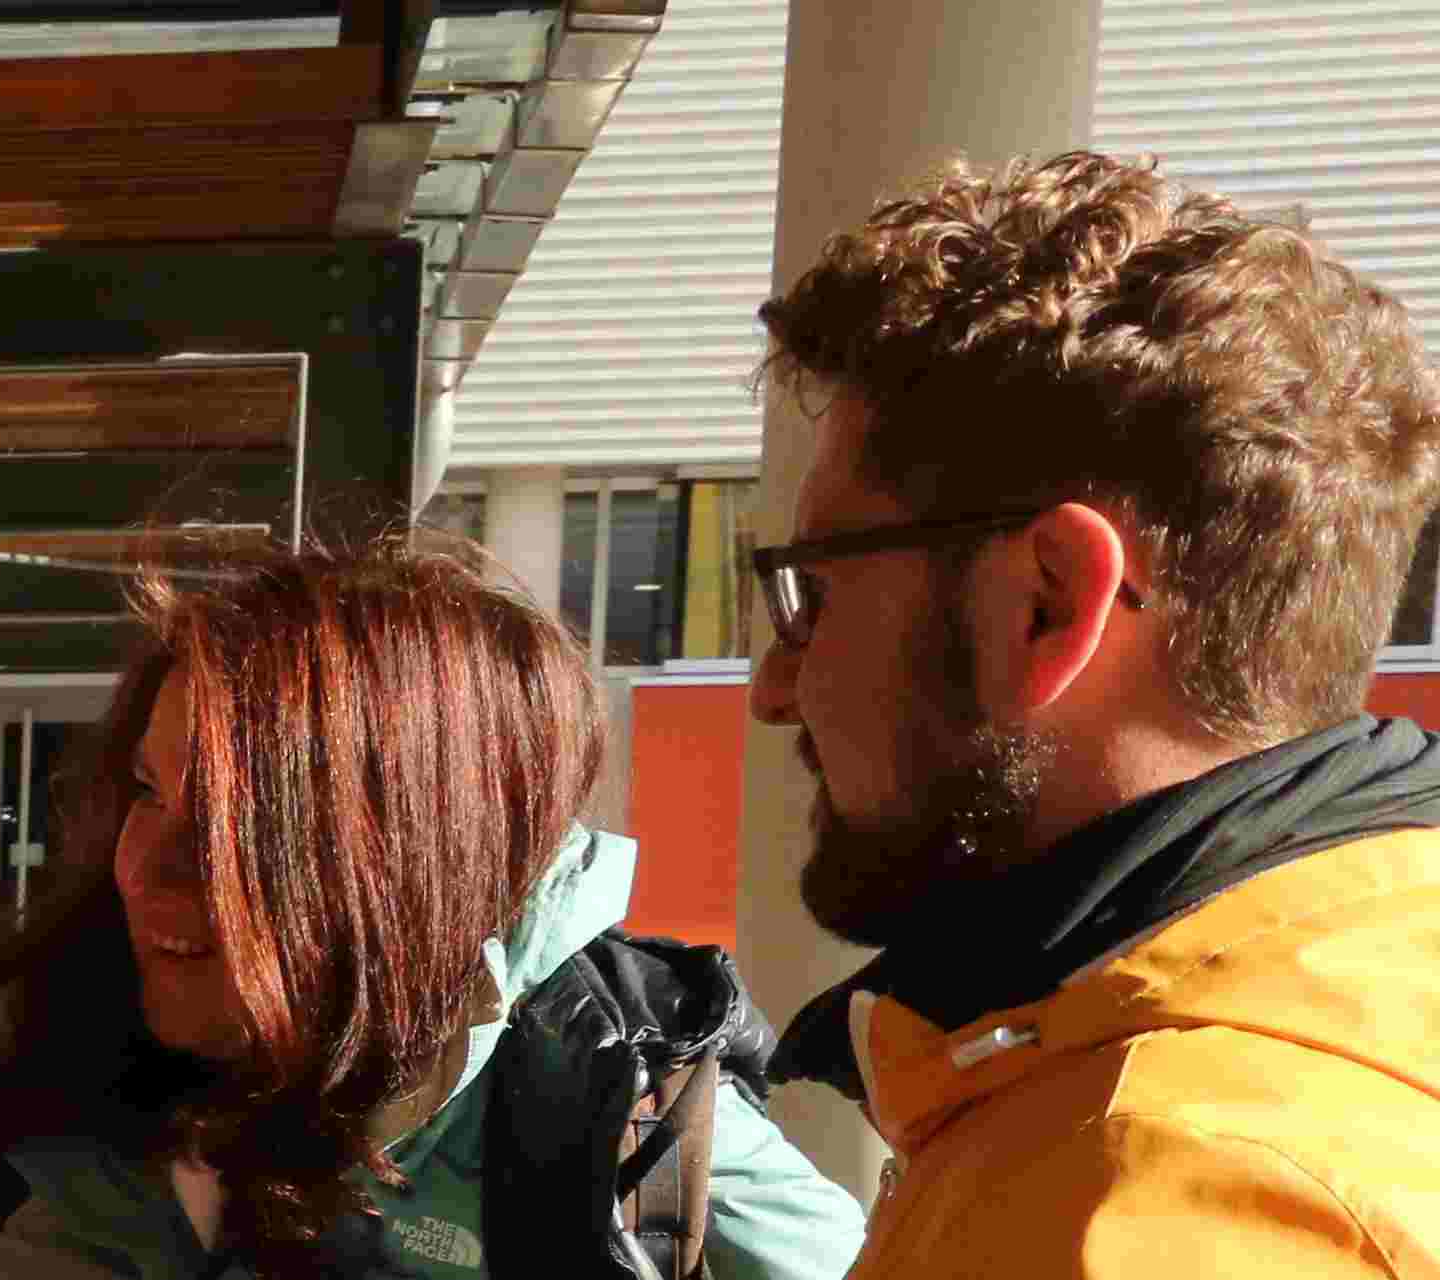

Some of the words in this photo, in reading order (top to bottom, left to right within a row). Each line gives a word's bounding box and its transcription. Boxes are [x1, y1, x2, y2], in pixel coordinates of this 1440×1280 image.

[391, 1218, 457, 1250] NORTH
[421, 1216, 457, 1233] THE
[401, 1238, 456, 1262] FACE
